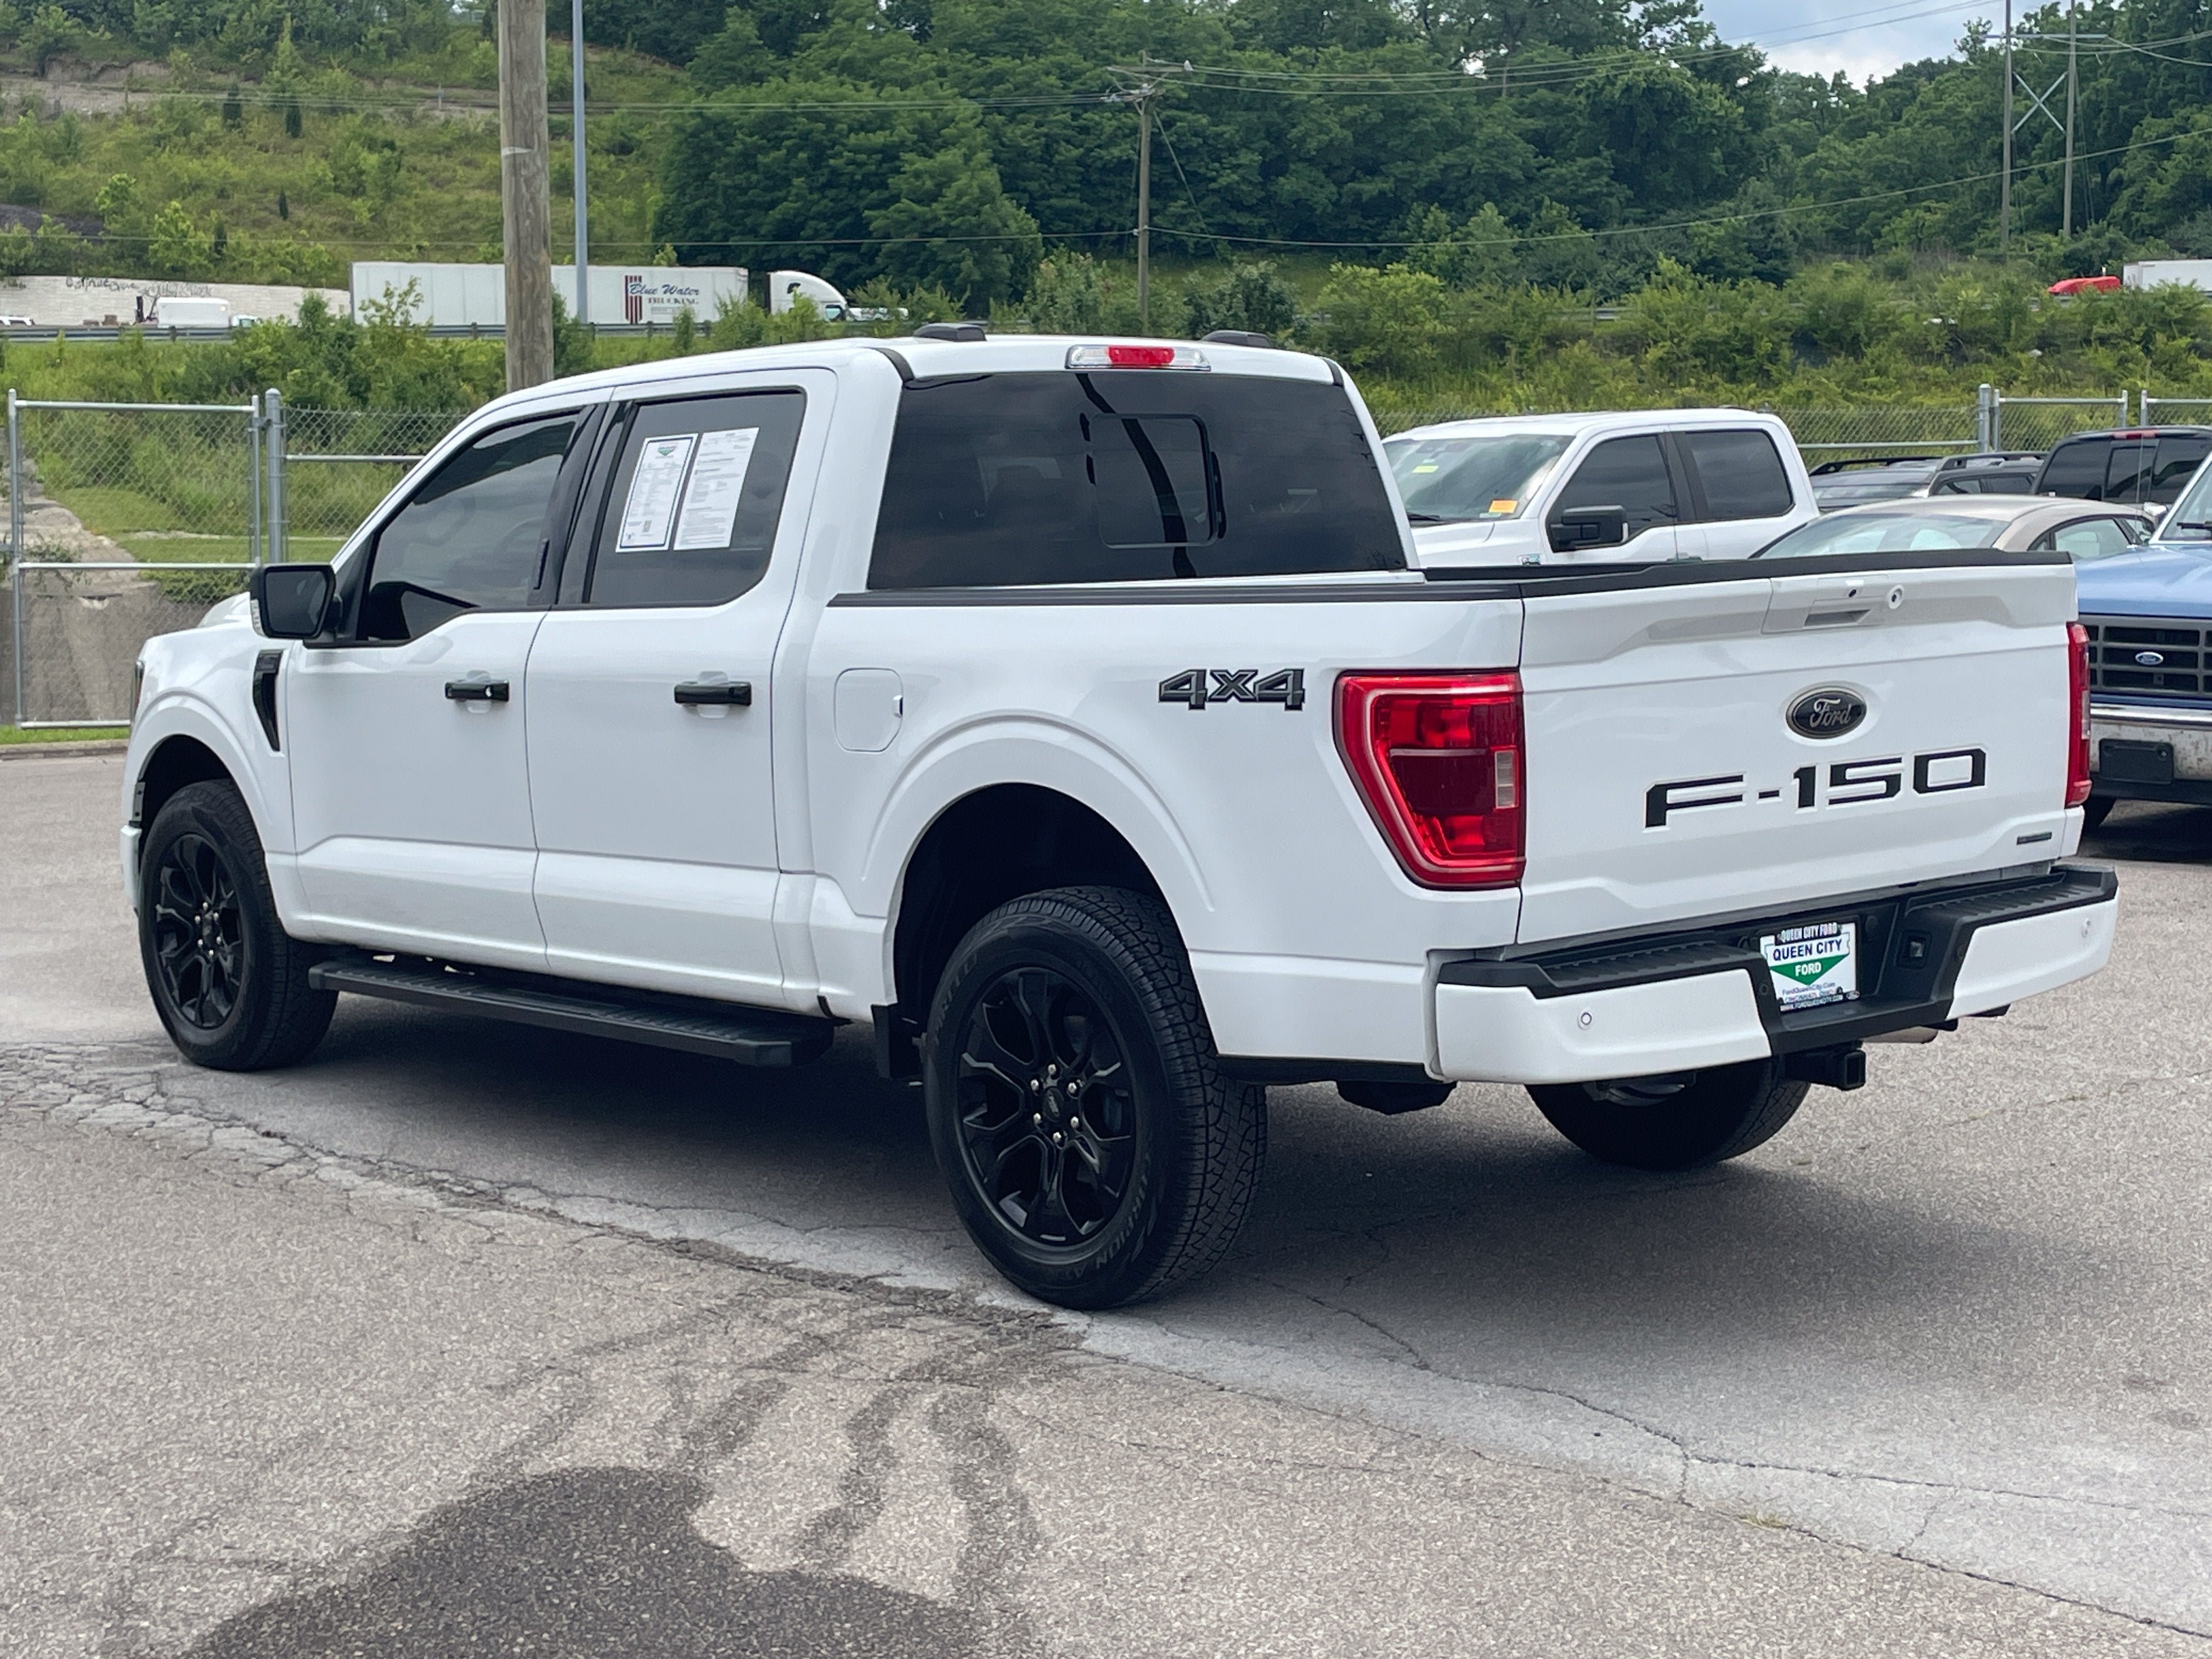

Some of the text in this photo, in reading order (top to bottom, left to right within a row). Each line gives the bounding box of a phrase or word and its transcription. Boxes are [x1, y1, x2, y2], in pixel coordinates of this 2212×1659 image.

[629, 283, 699, 296] Blue Water
[1810, 698, 1852, 728] Ford
[1645, 748, 1986, 828] F-150
[1781, 922, 1837, 943] QUEEN CITY FORD
[1773, 939, 1842, 961] QUEEN CITY
[1795, 962, 1821, 977] FORD
